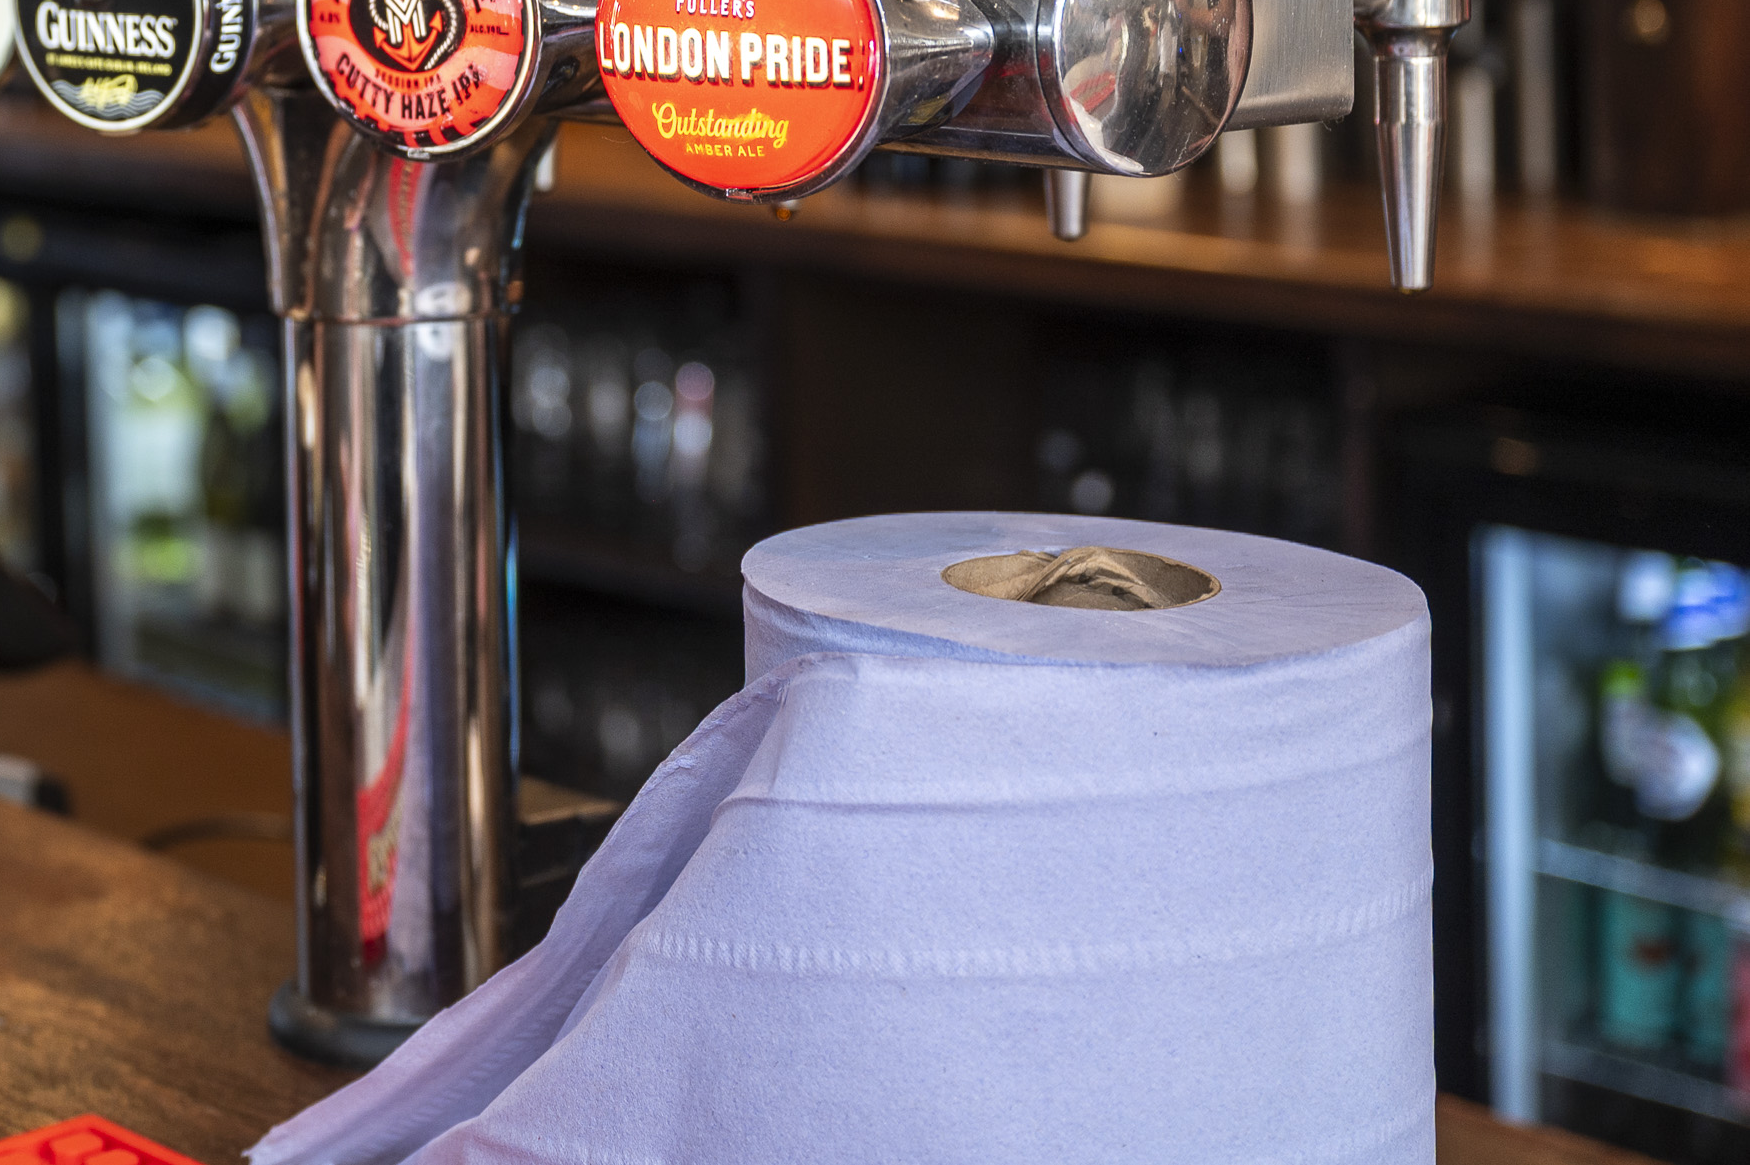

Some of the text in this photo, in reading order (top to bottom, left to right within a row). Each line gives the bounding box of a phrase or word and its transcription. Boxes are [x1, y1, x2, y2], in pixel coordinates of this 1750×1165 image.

[35, 0, 176, 58] GUINNESS
[600, 21, 852, 88] LONDON PRIDE
[337, 53, 394, 114] CUTTY
[402, 88, 450, 120] HAZE
[652, 102, 790, 149] Outstanding
[686, 143, 765, 157] AMBER ALE
